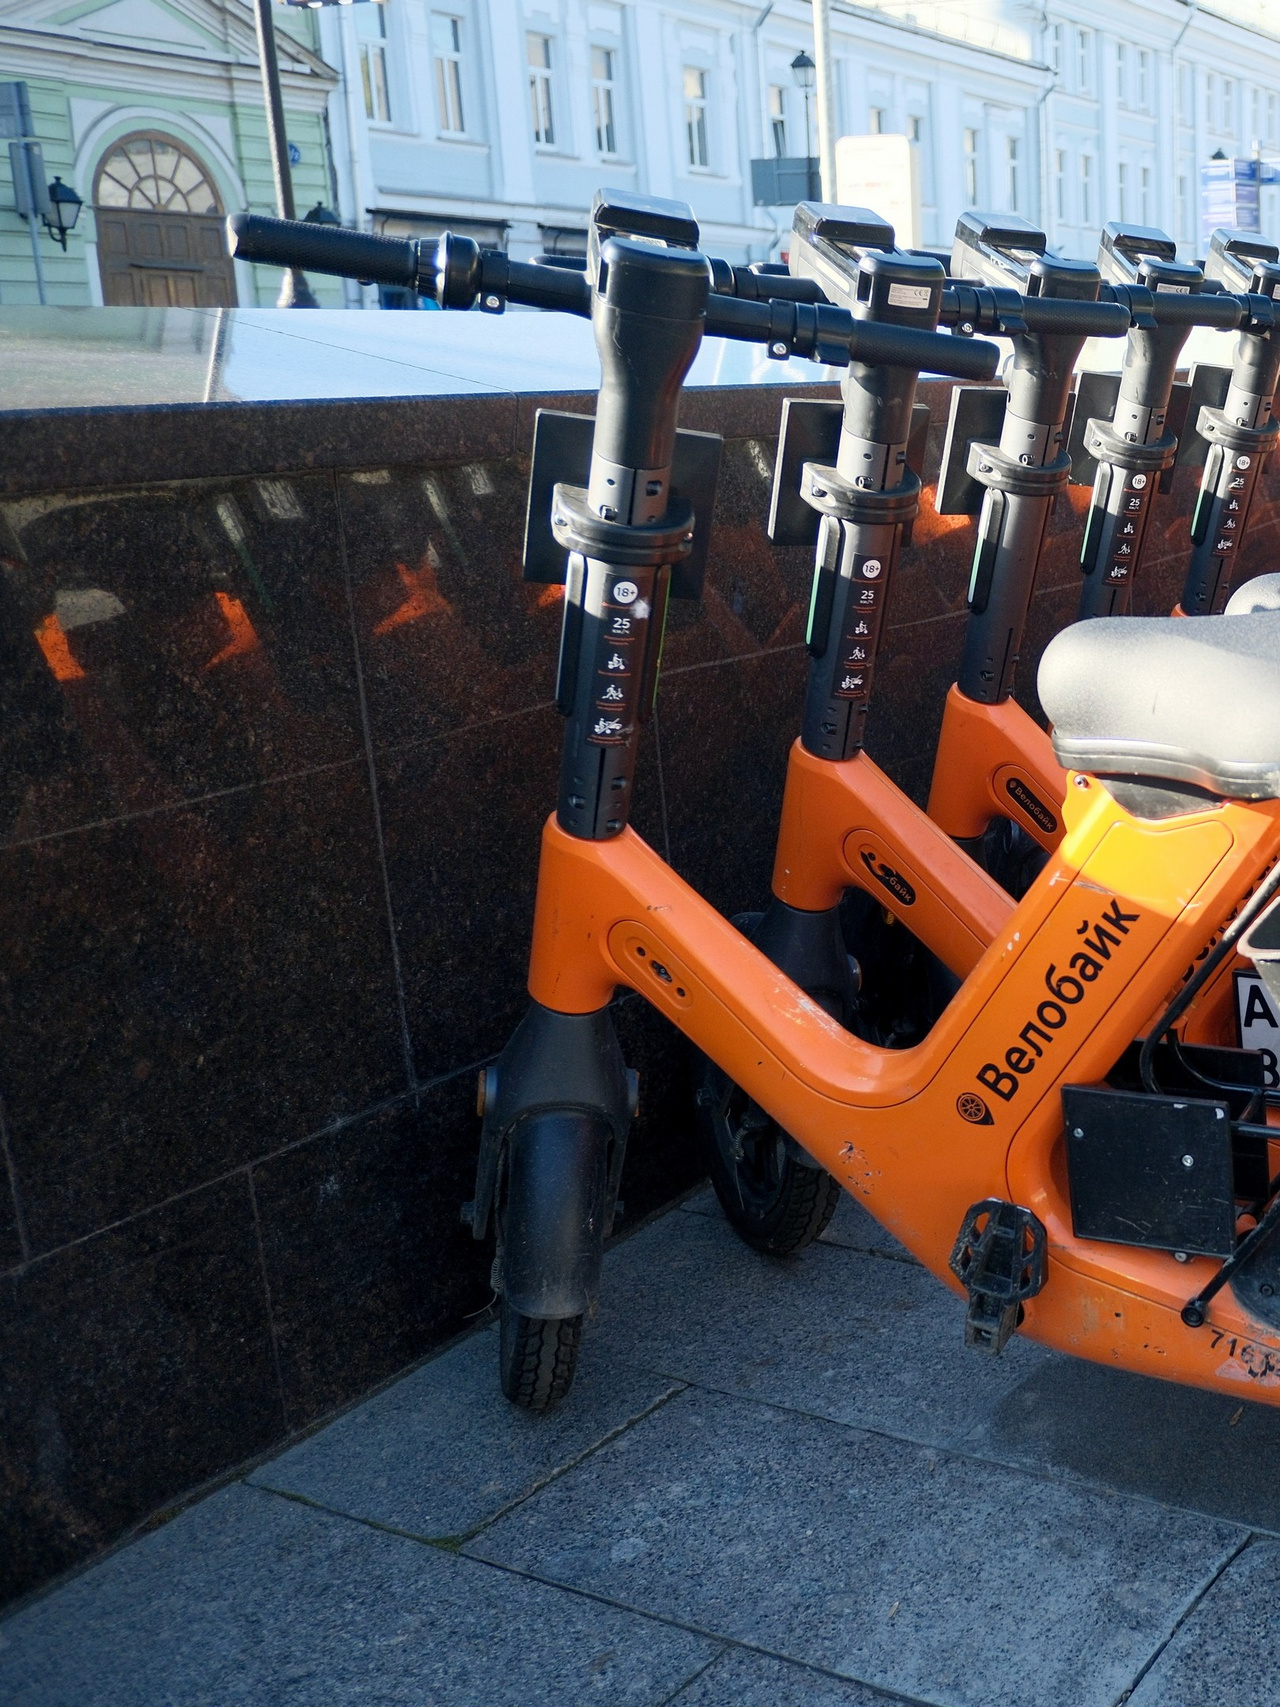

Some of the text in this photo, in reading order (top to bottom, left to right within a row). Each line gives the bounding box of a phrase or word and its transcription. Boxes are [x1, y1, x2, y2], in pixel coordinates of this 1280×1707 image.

[1129, 498, 1141, 506] 25
[865, 564, 880, 574] 18+
[617, 586, 636, 598] 18+
[860, 590, 875, 600] 25
[612, 617, 631, 629] 25
[1014, 786, 1054, 830] Велобайк
[976, 897, 1142, 1103] Велобайк
